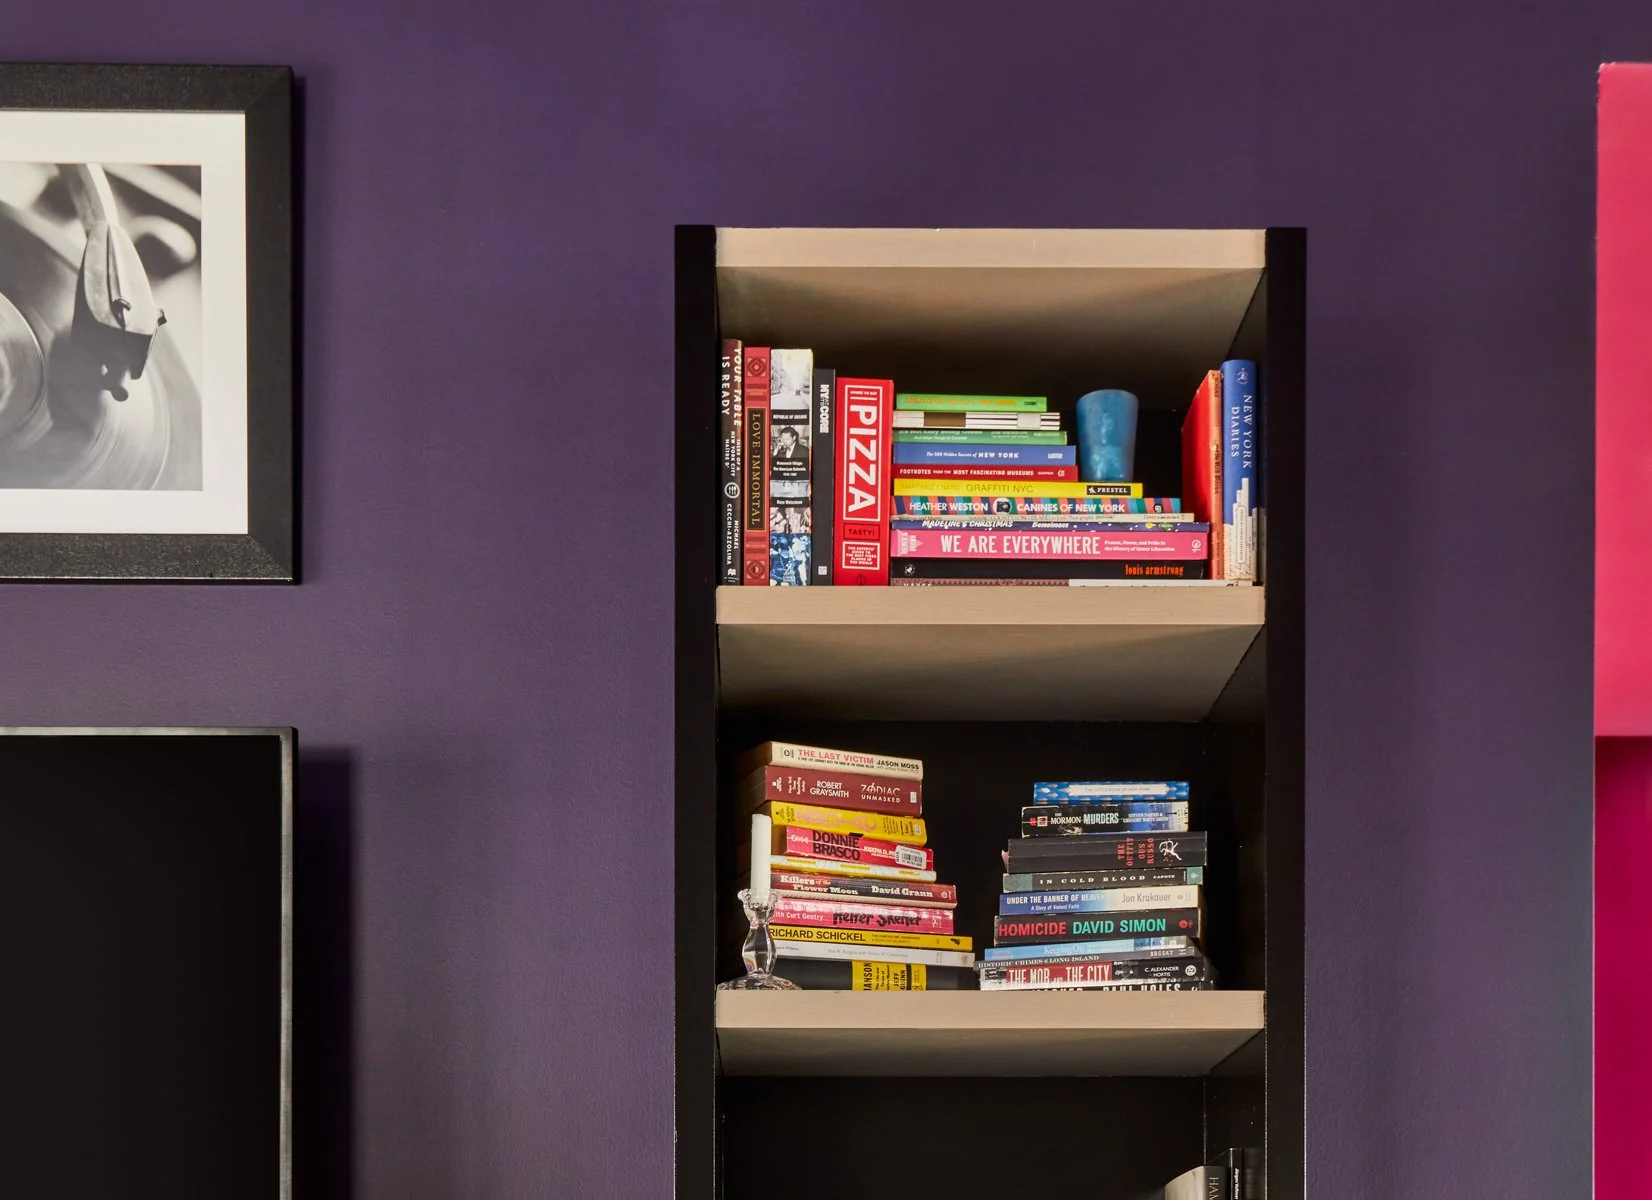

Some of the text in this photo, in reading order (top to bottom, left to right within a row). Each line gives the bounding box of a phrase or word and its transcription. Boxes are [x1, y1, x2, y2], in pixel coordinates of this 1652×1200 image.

[722, 356, 730, 415] IS READY
[734, 348, 742, 426] YOUR TABLE
[1231, 406, 1239, 457] DIARIES
[1243, 395, 1252, 468] NEW YORK
[848, 405, 878, 512] PIZZA
[752, 414, 760, 525] LOVE IMMORTAL
[1013, 485, 1034, 493] NYC
[910, 502, 988, 511] HEATHER WESTON
[1016, 503, 1125, 513] CANINES OF NEW YORK
[941, 535, 1100, 554] WE ARE EVERYWHERE
[1126, 564, 1184, 576] louis armstrong
[798, 749, 874, 764] THE LAST VICTIM
[877, 760, 899, 768] JASON
[900, 762, 919, 770] MOSS
[817, 781, 842, 789] ROBERT
[810, 788, 849, 798] GRAYSMITH
[862, 795, 900, 803] UNMASKED
[1051, 814, 1119, 824] MORMON MURDERS
[813, 830, 860, 848] DONNIE
[813, 843, 860, 860] BRASCO
[780, 875, 814, 885] Killers
[793, 884, 858, 895] Flower Moon
[871, 886, 933, 897] David Grann
[1006, 896, 1028, 905] UNDER
[1030, 896, 1042, 904] THE
[1044, 895, 1069, 903] BANNER
[1122, 893, 1171, 903] Jon Krakauer
[802, 913, 823, 922] Gentry
[998, 919, 1166, 936] HOMICIDE DAVID SIMON
[769, 929, 866, 942] RICHARD SCHICKEL
[1009, 964, 1110, 984] THE MOB THE CITY
